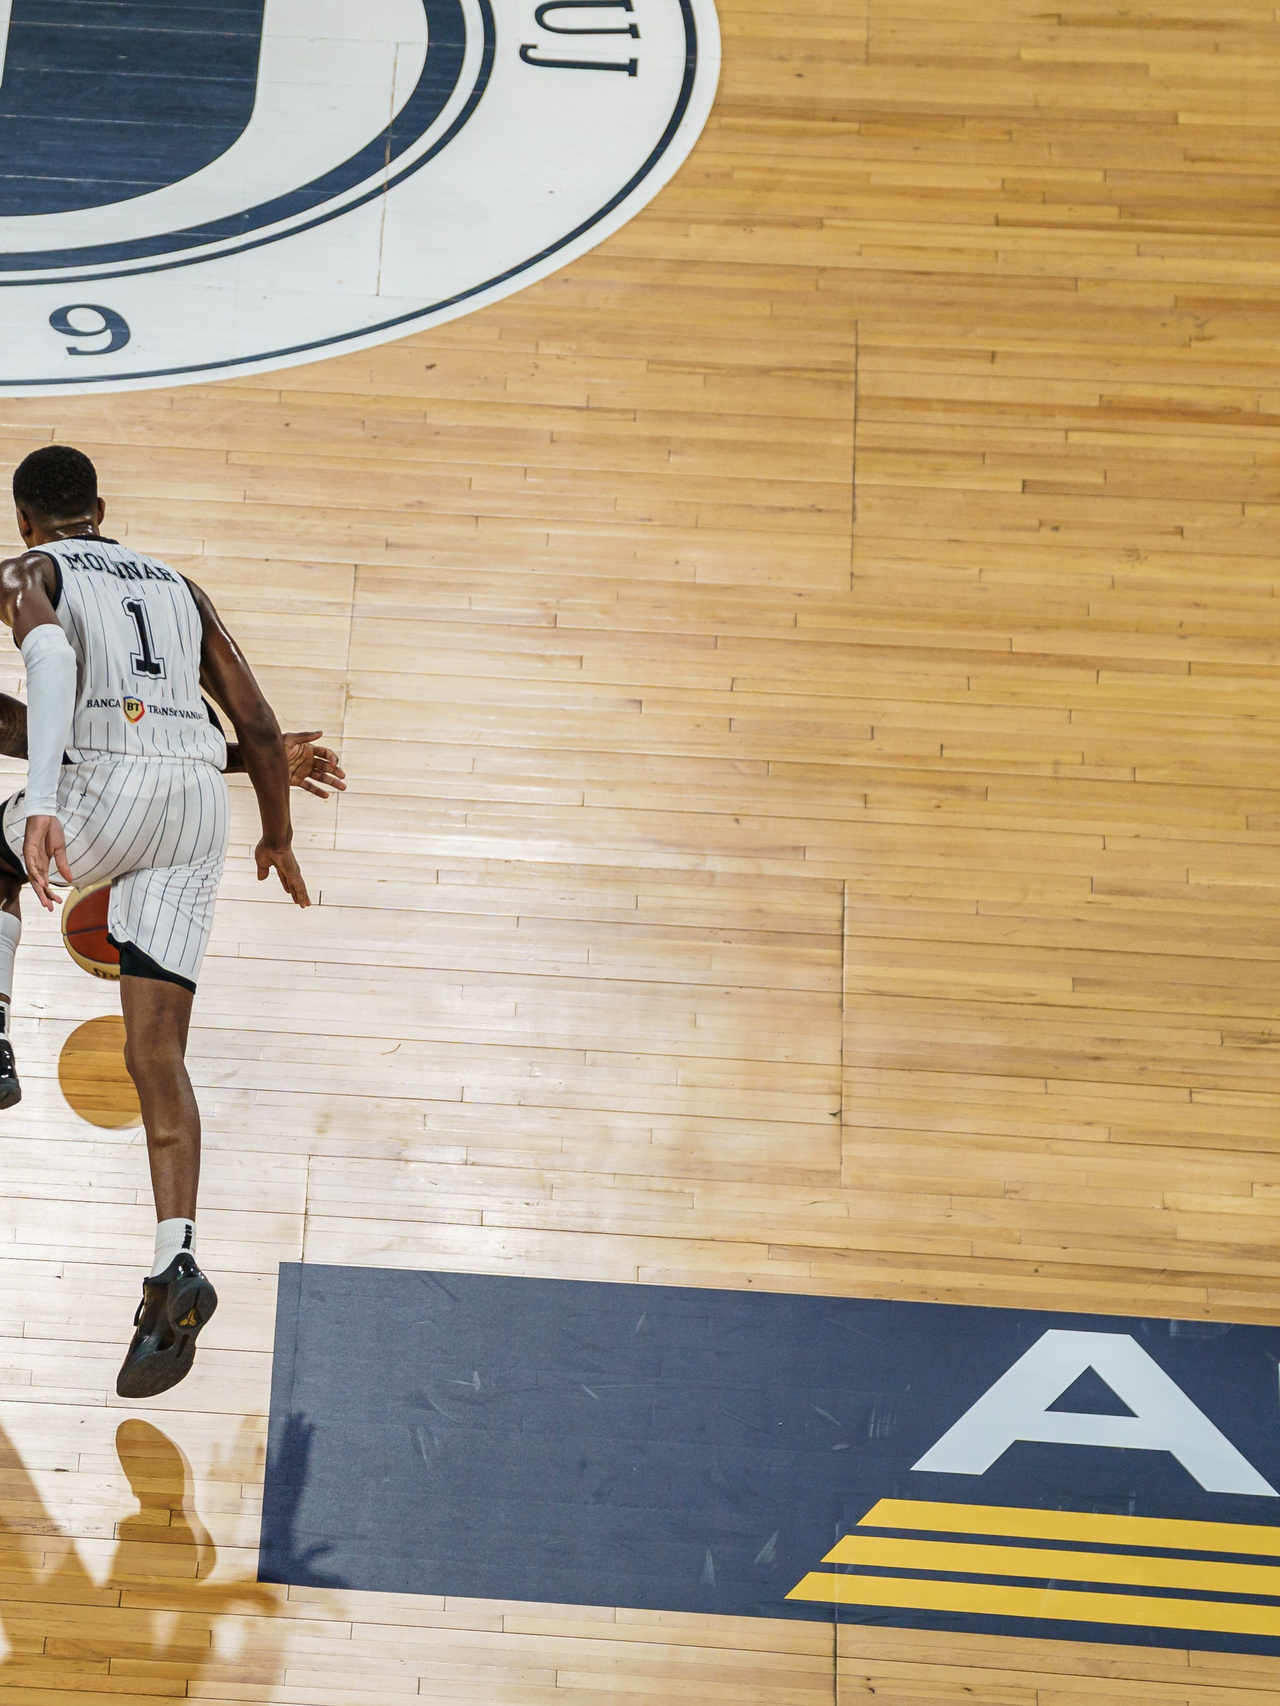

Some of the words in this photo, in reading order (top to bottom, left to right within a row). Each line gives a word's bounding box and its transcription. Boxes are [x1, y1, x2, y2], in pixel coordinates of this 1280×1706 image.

[60, 551, 180, 585] MOLINAR
[122, 597, 167, 680] 1
[86, 698, 121, 709] BANCA
[126, 702, 141, 711] BT
[910, 1328, 1280, 1497] A
